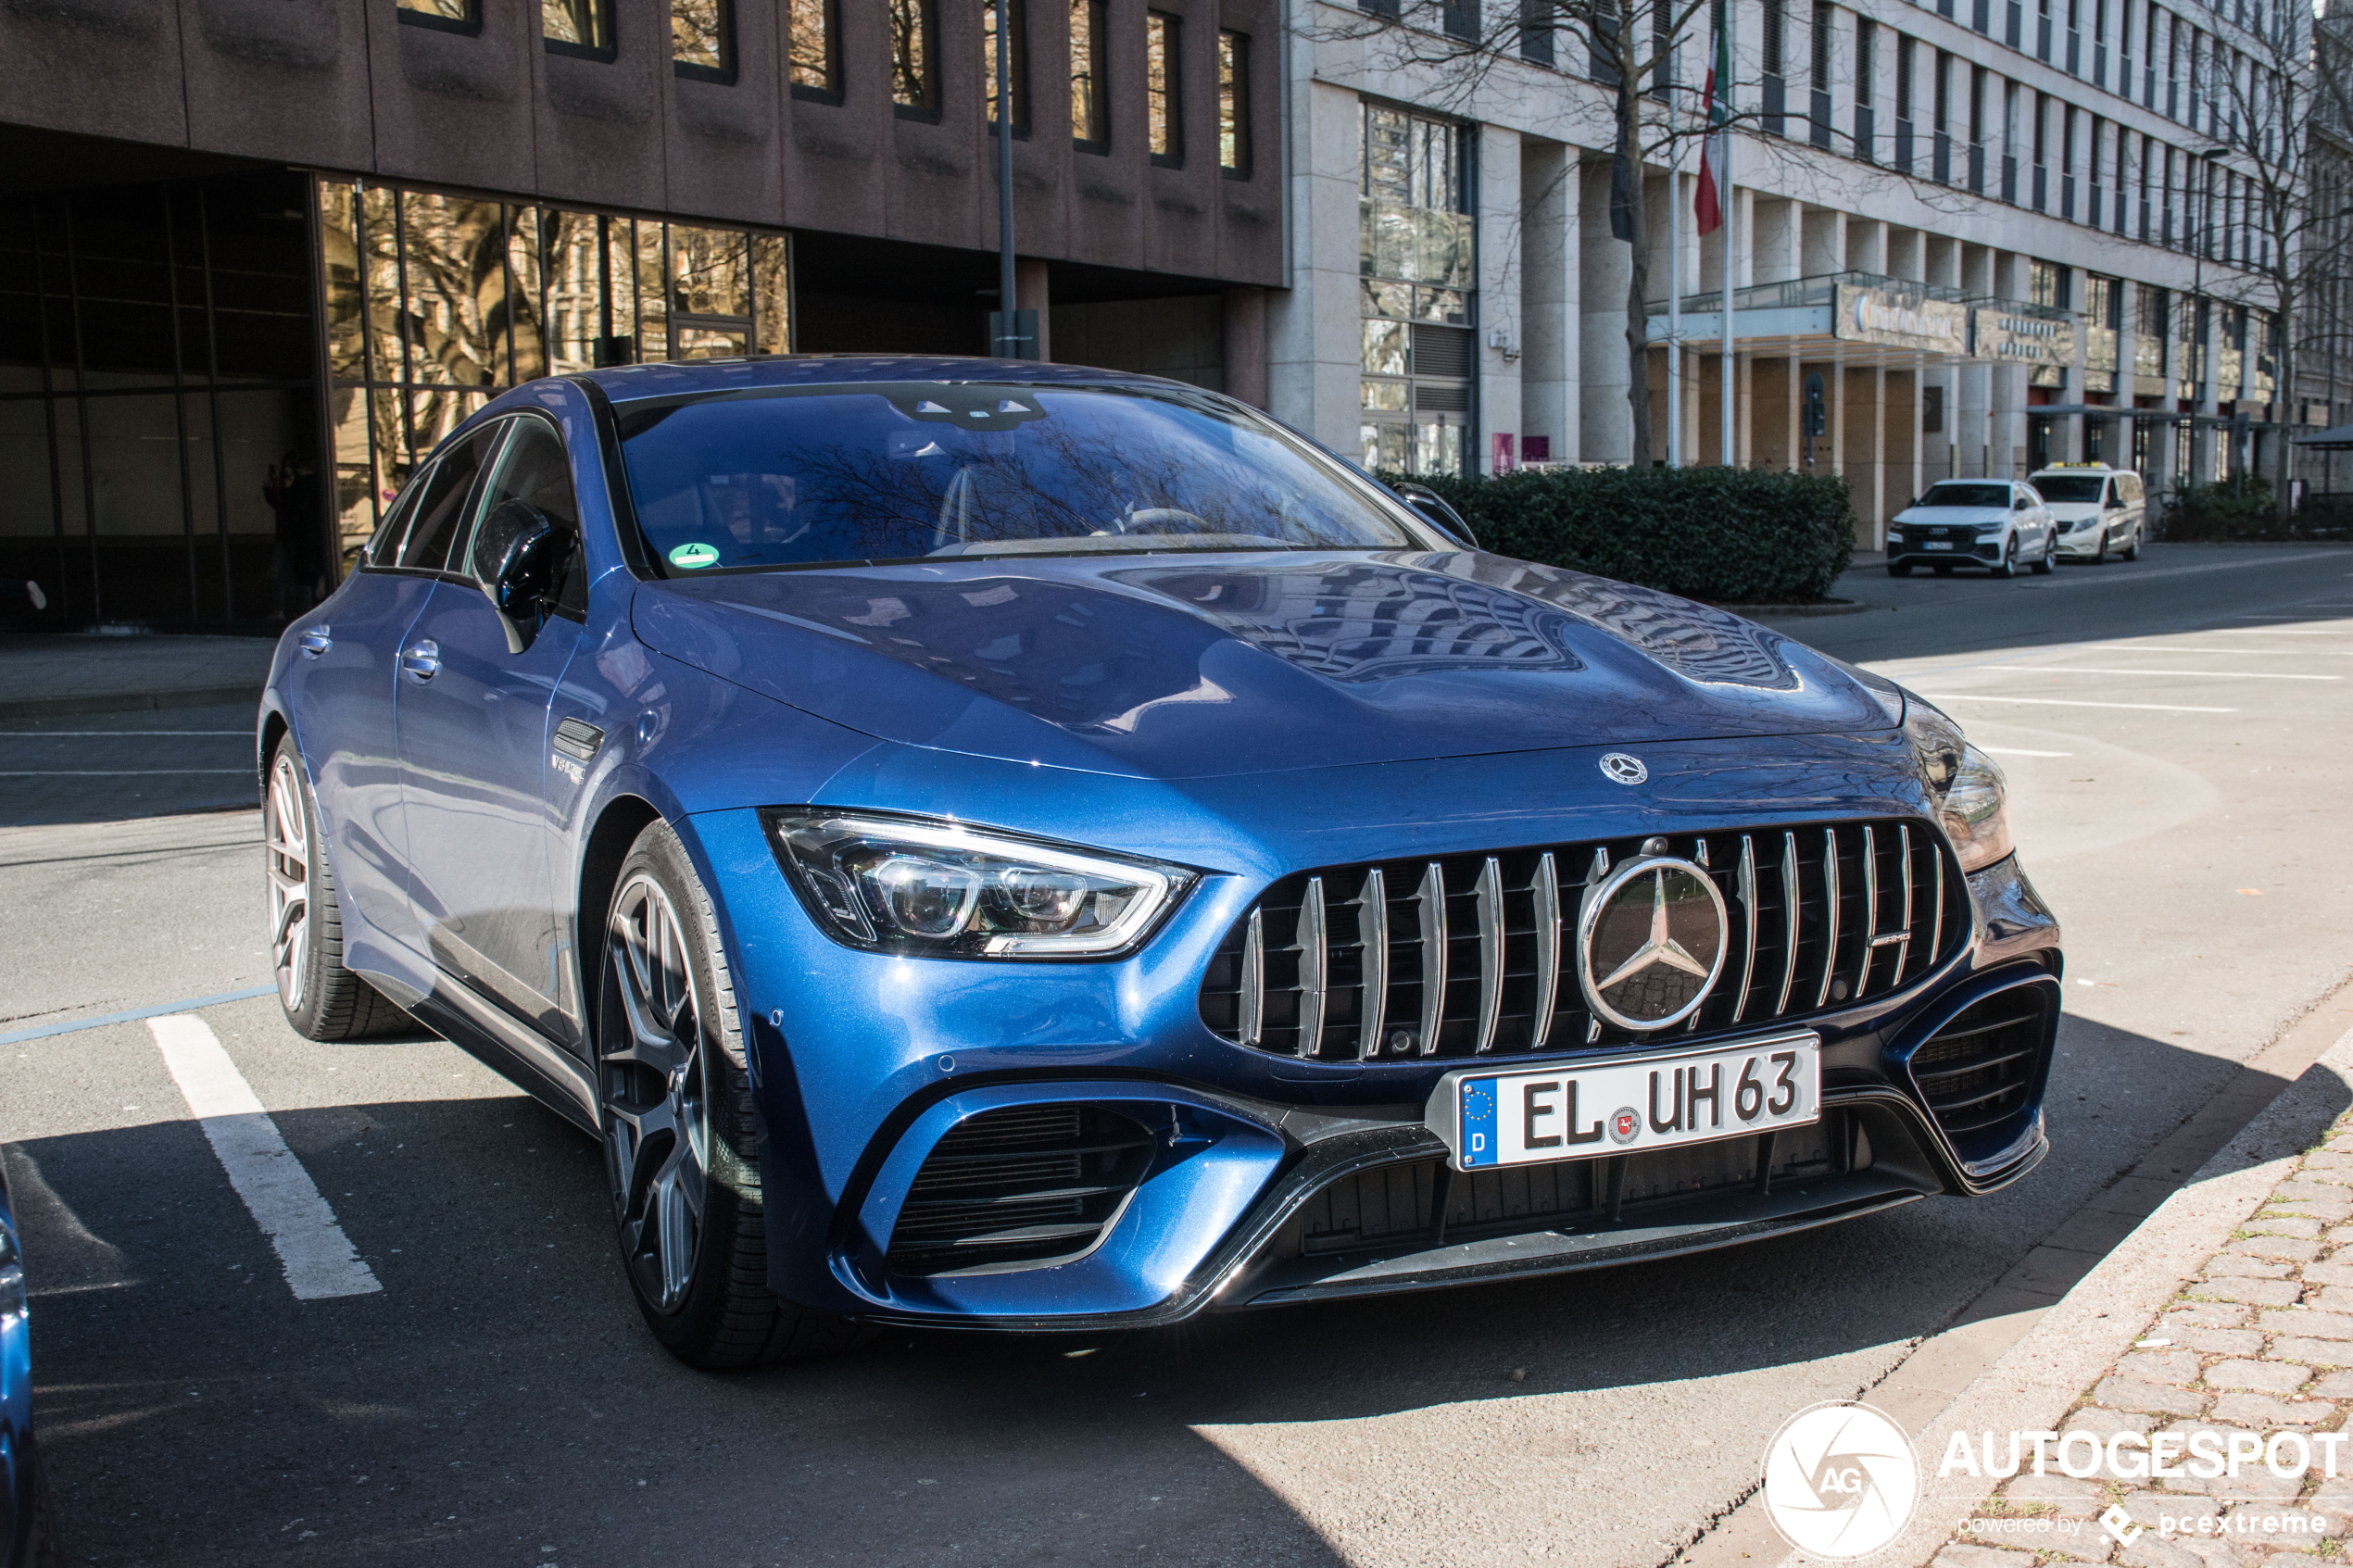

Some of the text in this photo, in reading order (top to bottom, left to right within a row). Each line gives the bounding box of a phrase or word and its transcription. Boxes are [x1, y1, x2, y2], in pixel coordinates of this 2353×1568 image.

[686, 545, 701, 555] 4
[1887, 934, 1910, 943] AMG
[1523, 1051, 1796, 1149] EL UH 63
[1472, 1133, 1485, 1152] D
